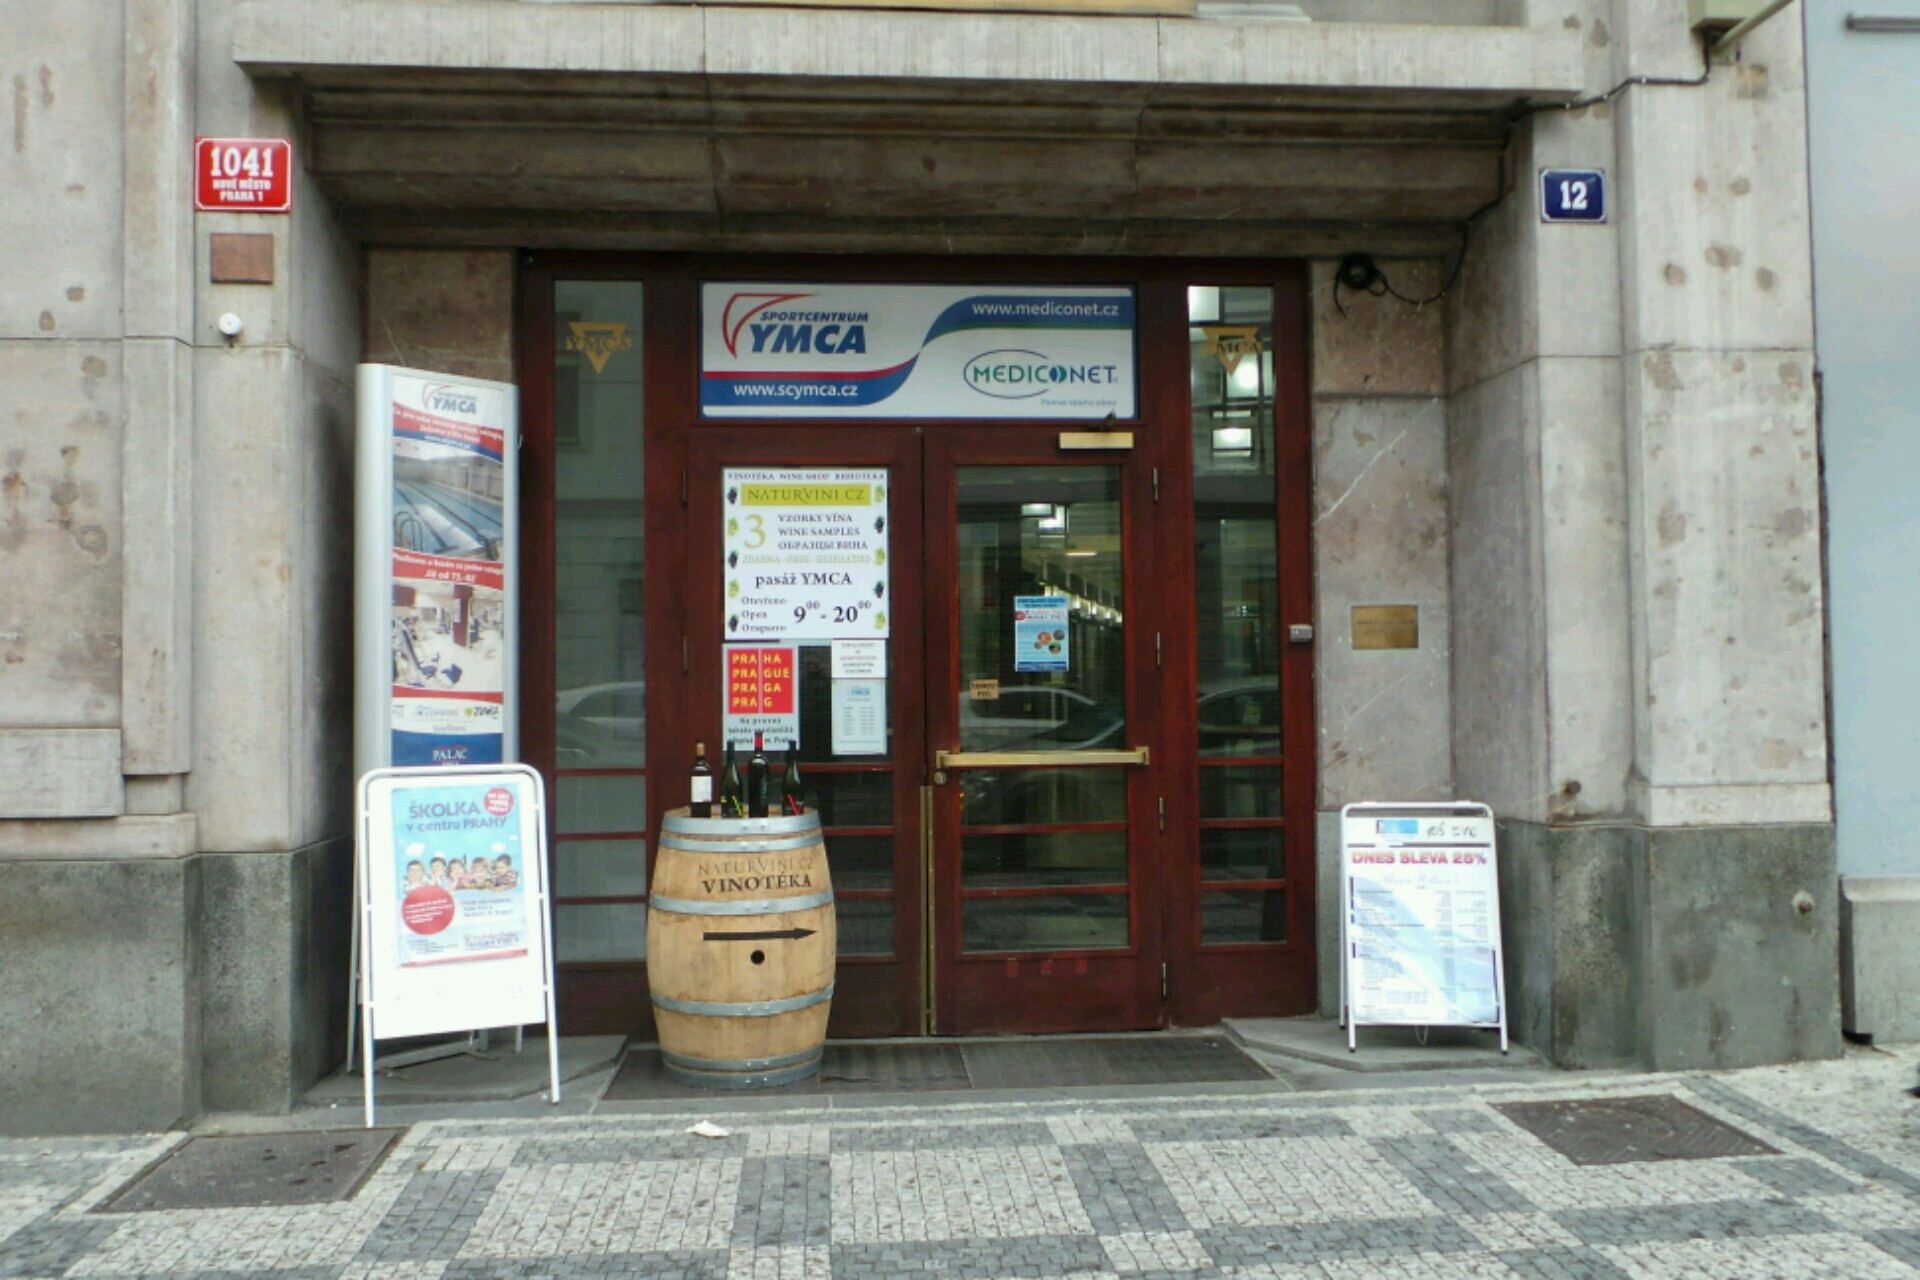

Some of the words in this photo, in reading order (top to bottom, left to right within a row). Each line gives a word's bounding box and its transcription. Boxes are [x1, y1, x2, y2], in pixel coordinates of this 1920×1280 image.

[210, 147, 273, 177] 1041
[212, 178, 238, 191] NOVÉ
[238, 177, 272, 191] MĚSTO
[220, 190, 255, 202] PRAHA
[257, 190, 264, 202] 1
[1560, 180, 1588, 210] 12
[971, 301, 1120, 317] www.mediconet.cz
[760, 311, 869, 323] SPORTCENTRUM
[749, 323, 867, 355] YMCA
[973, 365, 1117, 384] MEDICONET
[733, 384, 859, 400] www.scymca.cz
[433, 396, 477, 414] YMCA
[727, 472, 775, 480] VINOTÉKA
[778, 514, 823, 523] VZORKY
[825, 512, 853, 523] VÍNA
[743, 513, 767, 549] 3
[778, 527, 807, 536] WINE
[809, 527, 860, 537] SAMPLES
[755, 572, 797, 588] pasáž
[801, 573, 852, 585] YMCA
[741, 597, 787, 605] Otevřeno
[741, 610, 767, 620] Open
[732, 654, 757, 664] PRA
[763, 654, 781, 664] HA
[732, 669, 757, 678] PRA
[763, 668, 789, 678] GUE
[732, 683, 757, 692] PRA
[763, 682, 781, 692] GA
[732, 697, 757, 706] PRA
[763, 696, 773, 706] G
[409, 801, 480, 818] ŠKOLKA
[418, 821, 461, 832] centru
[464, 816, 507, 829] PRAHY
[1352, 852, 1396, 864] DNES
[1400, 852, 1448, 864] SLEVA
[702, 872, 812, 894] VINOTÉKA
